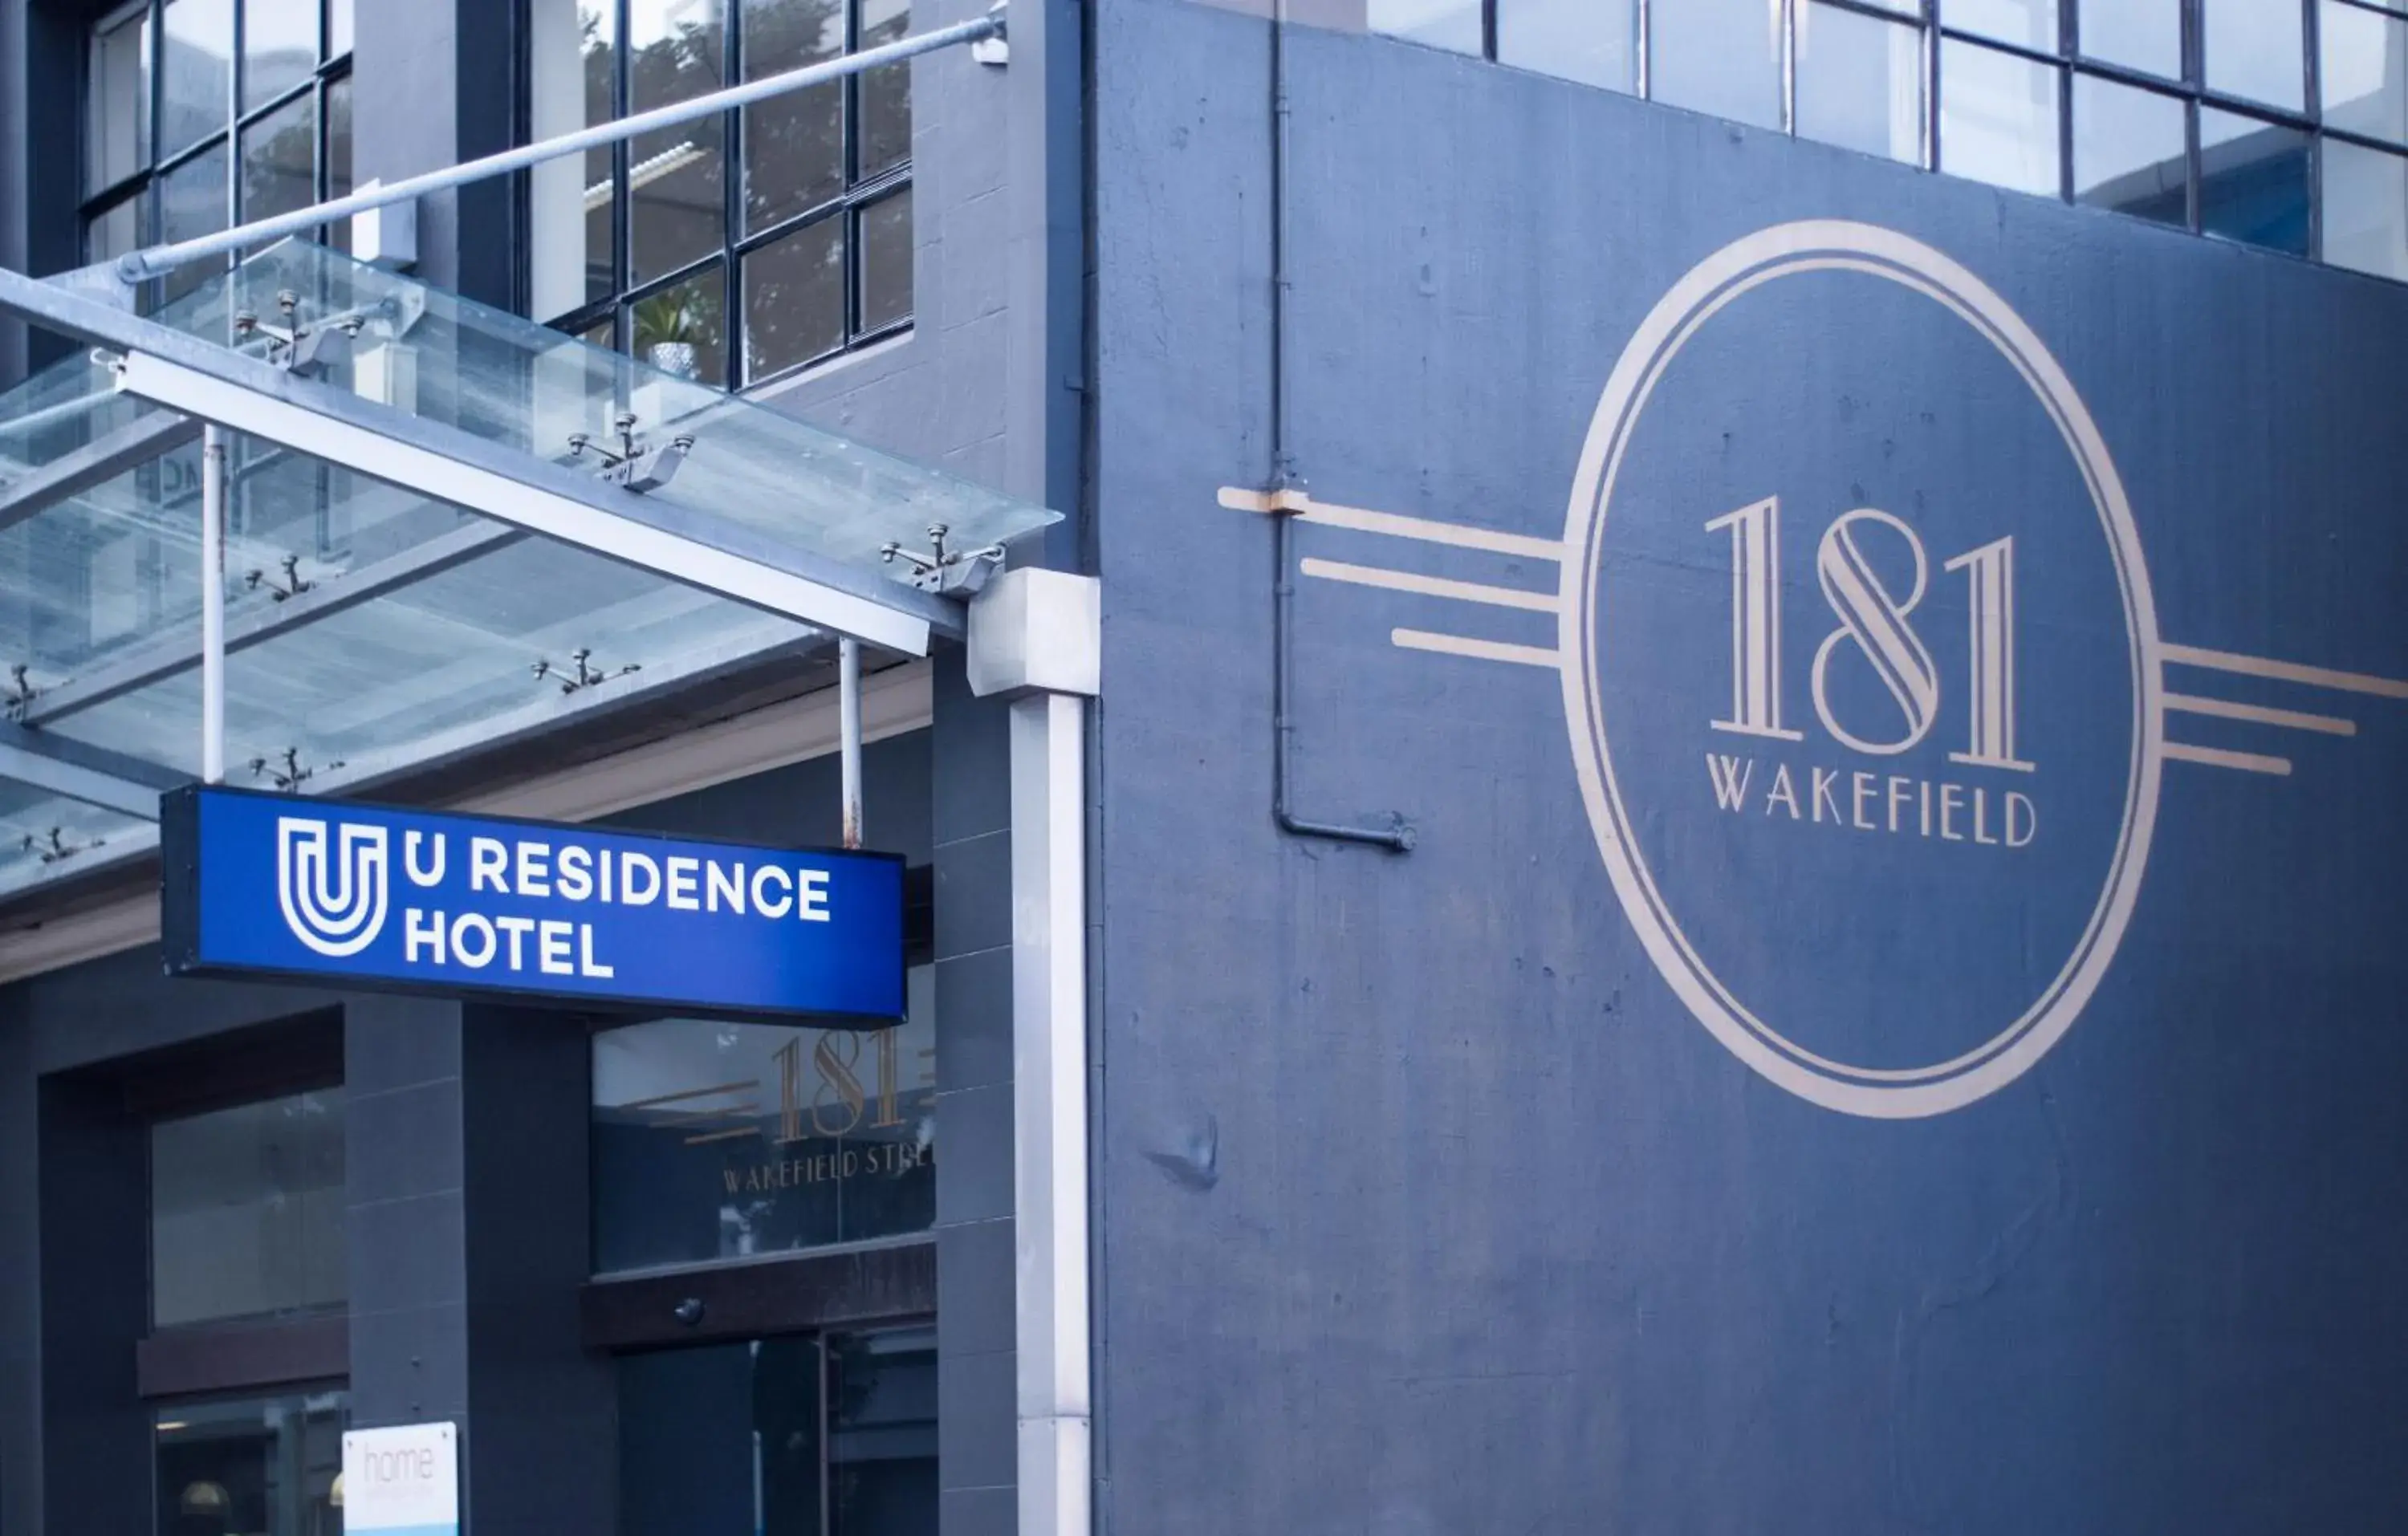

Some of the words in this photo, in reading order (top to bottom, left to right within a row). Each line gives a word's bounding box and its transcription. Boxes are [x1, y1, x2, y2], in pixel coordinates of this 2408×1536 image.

[1705, 495, 2036, 773] 181
[1706, 754, 2036, 847] WAKEFIELD
[405, 829, 446, 888] U
[470, 836, 831, 922] RESIDENCE
[405, 907, 615, 979] HOTEL
[771, 1028, 906, 1144] 181
[723, 1152, 858, 1193] WAKEFIELD
[864, 1141, 935, 1175] STRE
[364, 1441, 435, 1482] home
